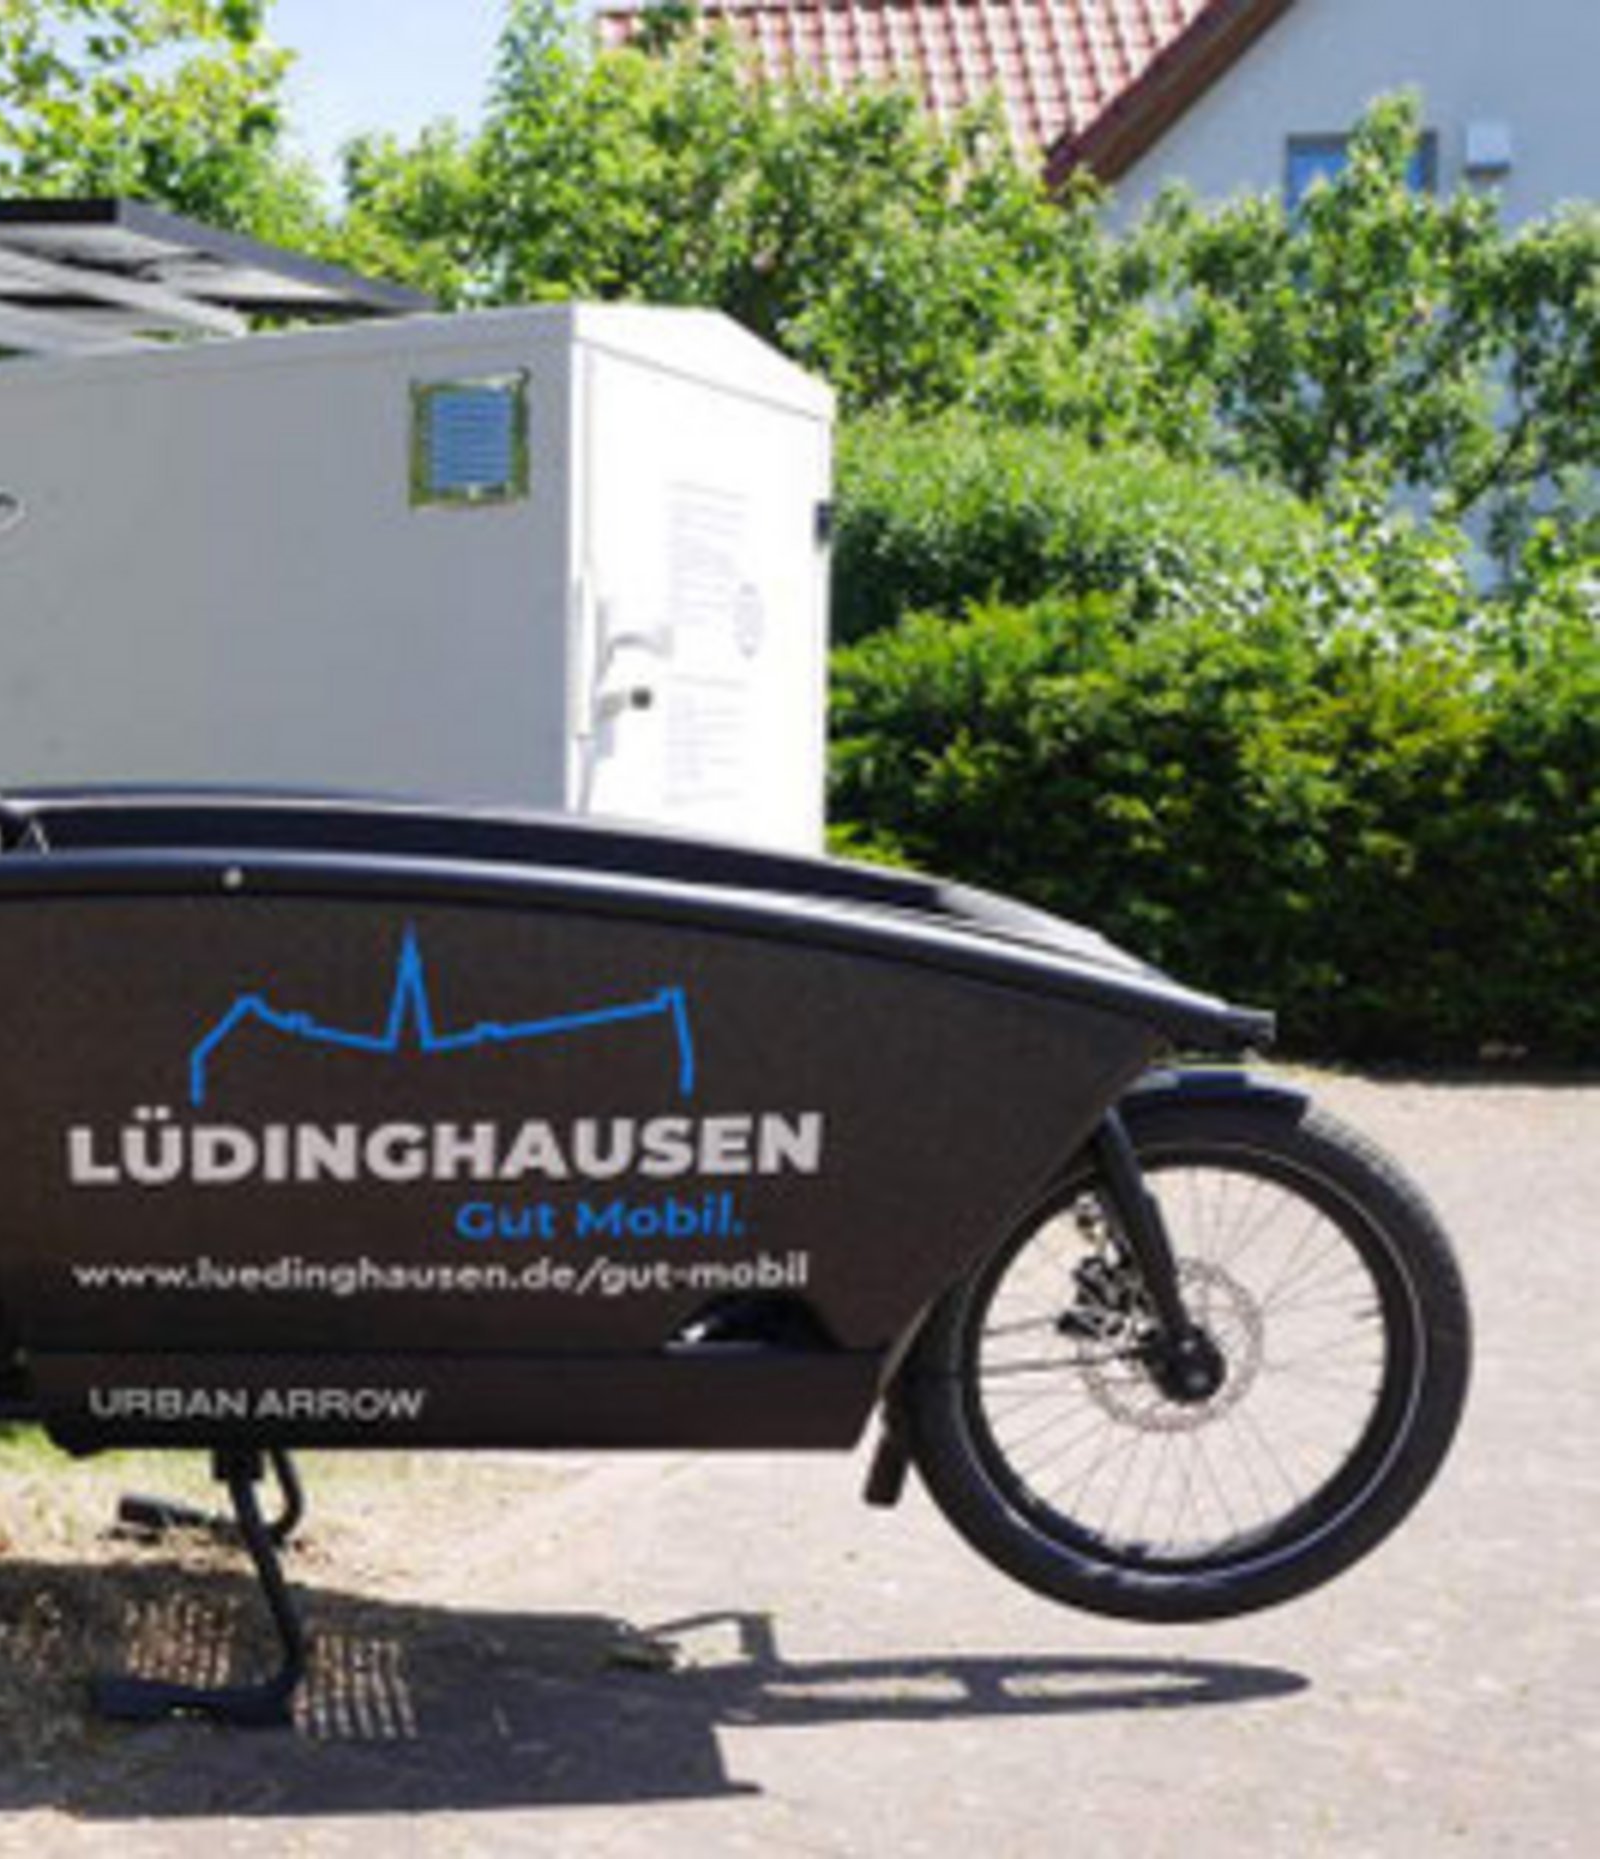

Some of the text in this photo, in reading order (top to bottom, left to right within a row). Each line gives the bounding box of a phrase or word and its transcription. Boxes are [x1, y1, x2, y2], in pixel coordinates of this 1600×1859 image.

[68, 1106, 823, 1183] LÜDINGHAUSEN
[454, 1191, 745, 1241] Gut Mobil.
[73, 1250, 809, 1297] www.luedinghausen.de/gut-mobil
[88, 1387, 426, 1420] URBAN ARROW
